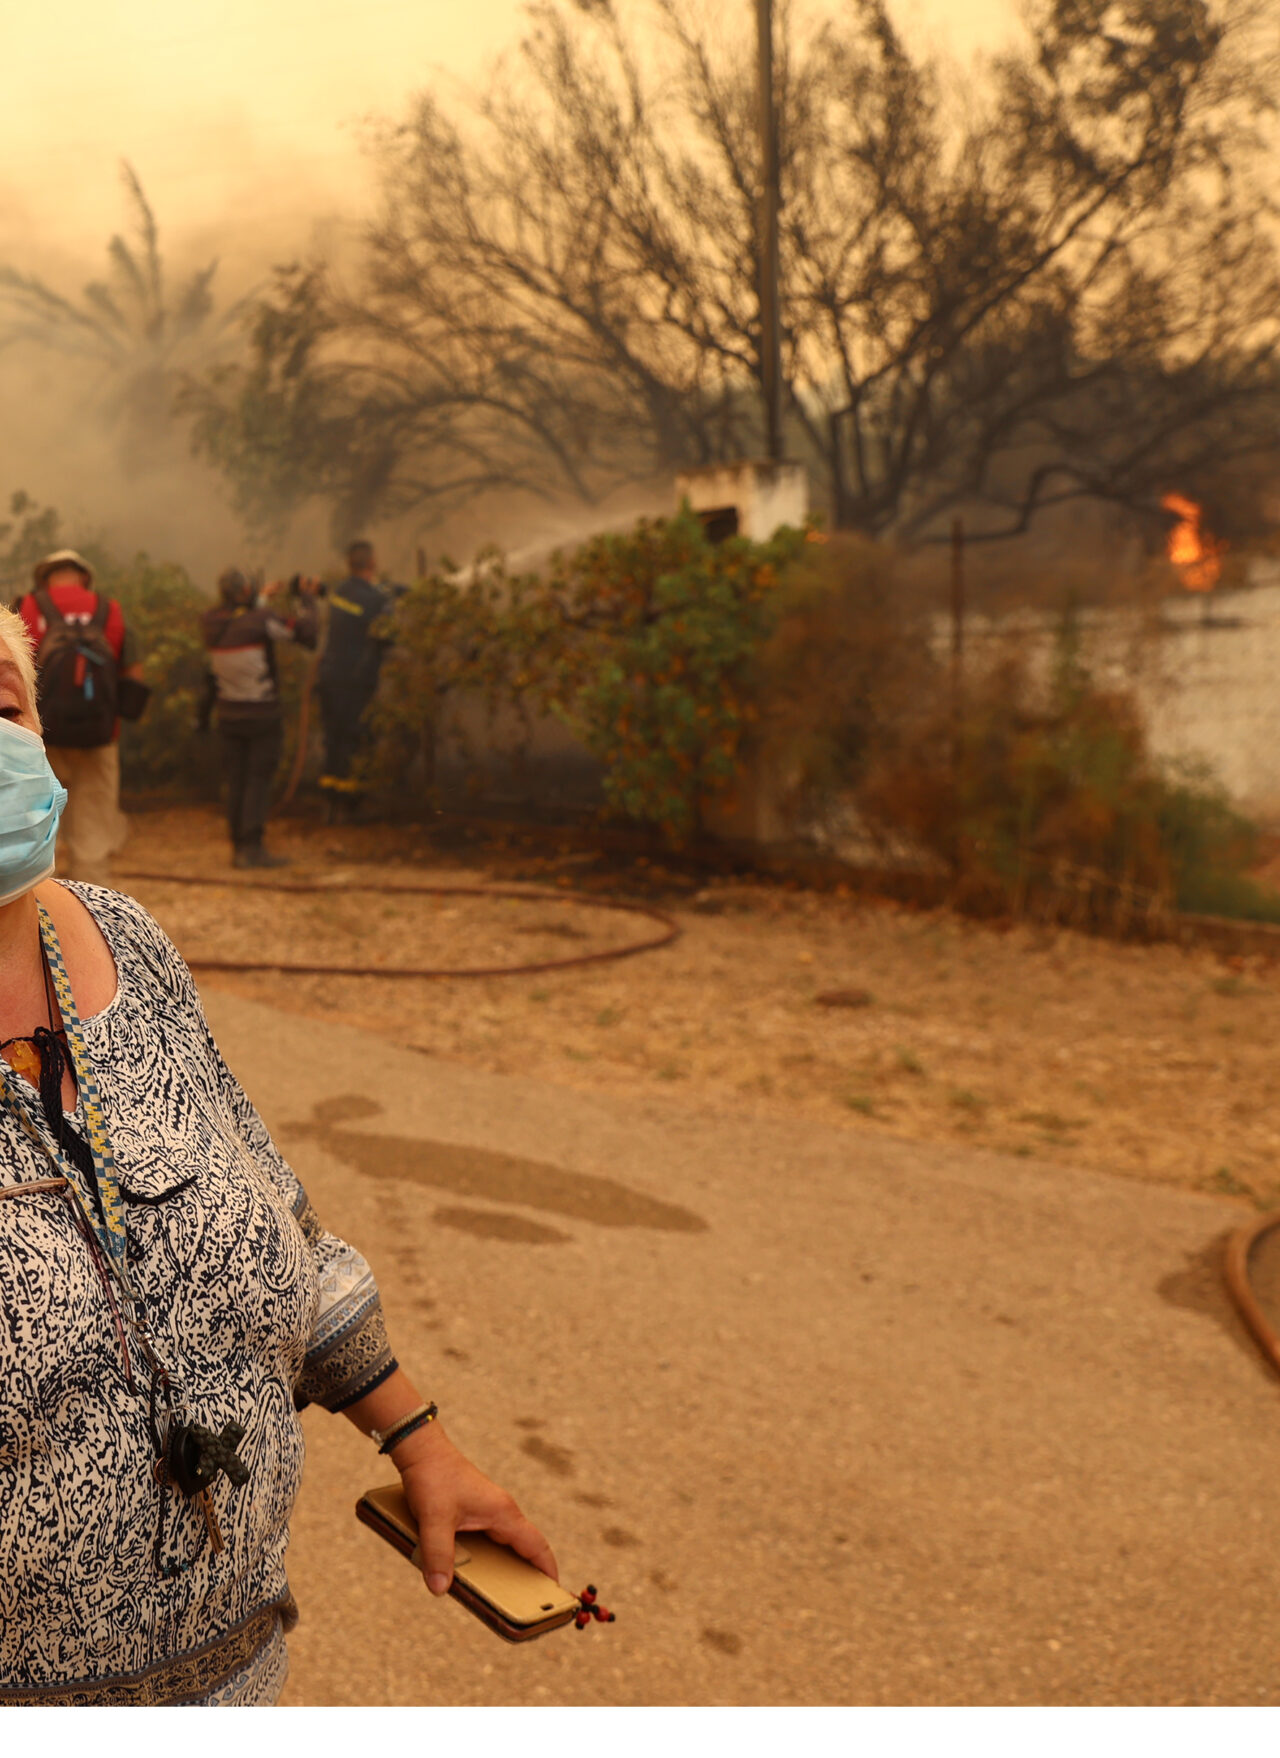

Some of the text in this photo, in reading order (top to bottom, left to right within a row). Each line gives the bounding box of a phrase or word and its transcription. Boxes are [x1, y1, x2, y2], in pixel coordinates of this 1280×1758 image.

[54, 969, 74, 1012] HELLAS
[69, 1034, 92, 1078] HELLAS
[86, 1105, 107, 1153] HELLAS
[101, 1180, 122, 1233] HELLAS
